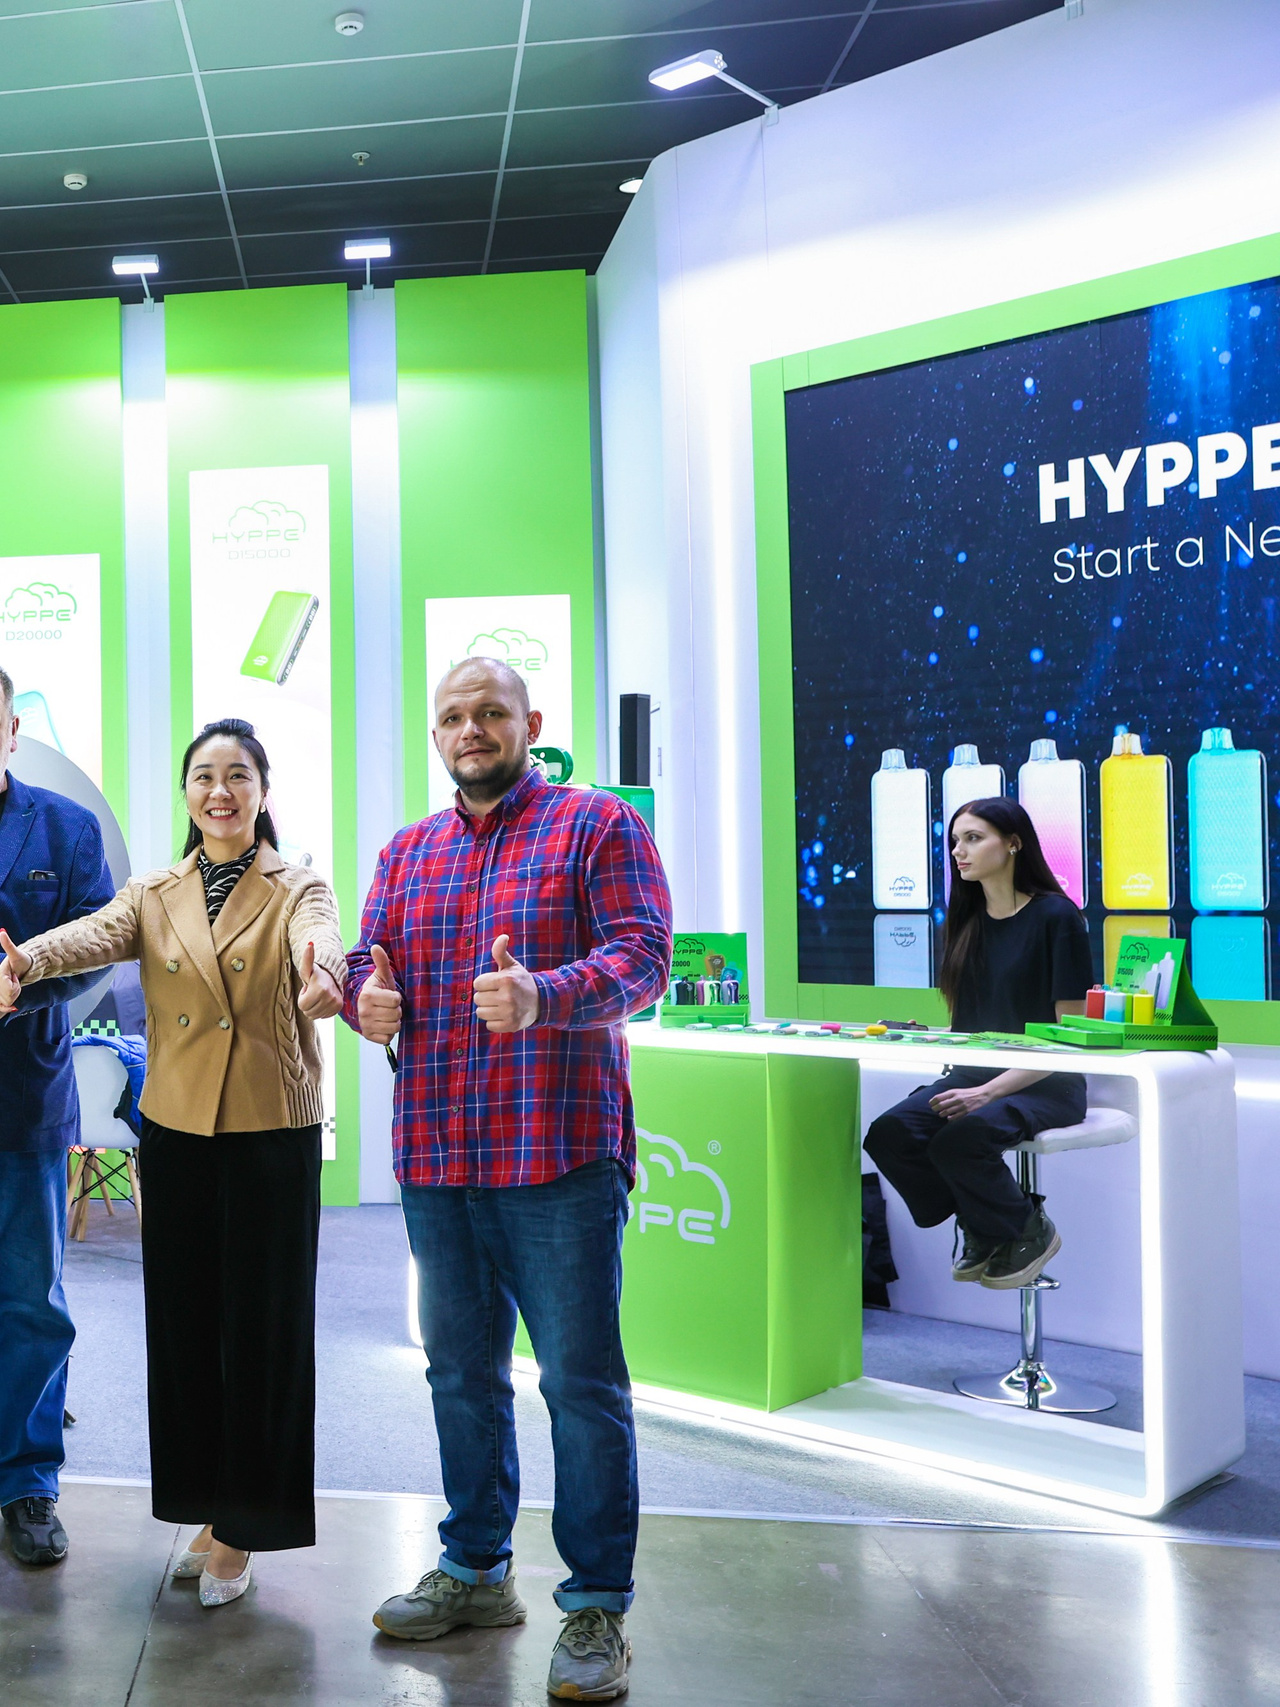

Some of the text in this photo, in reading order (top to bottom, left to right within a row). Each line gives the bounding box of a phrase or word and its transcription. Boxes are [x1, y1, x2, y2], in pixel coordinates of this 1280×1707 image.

[1038, 422, 1280, 524] HYPPE
[212, 528, 300, 544] HYPPE
[228, 547, 291, 560] D15000
[1053, 536, 1161, 583] Start
[1175, 536, 1204, 568] a
[5, 629, 63, 641] D20000
